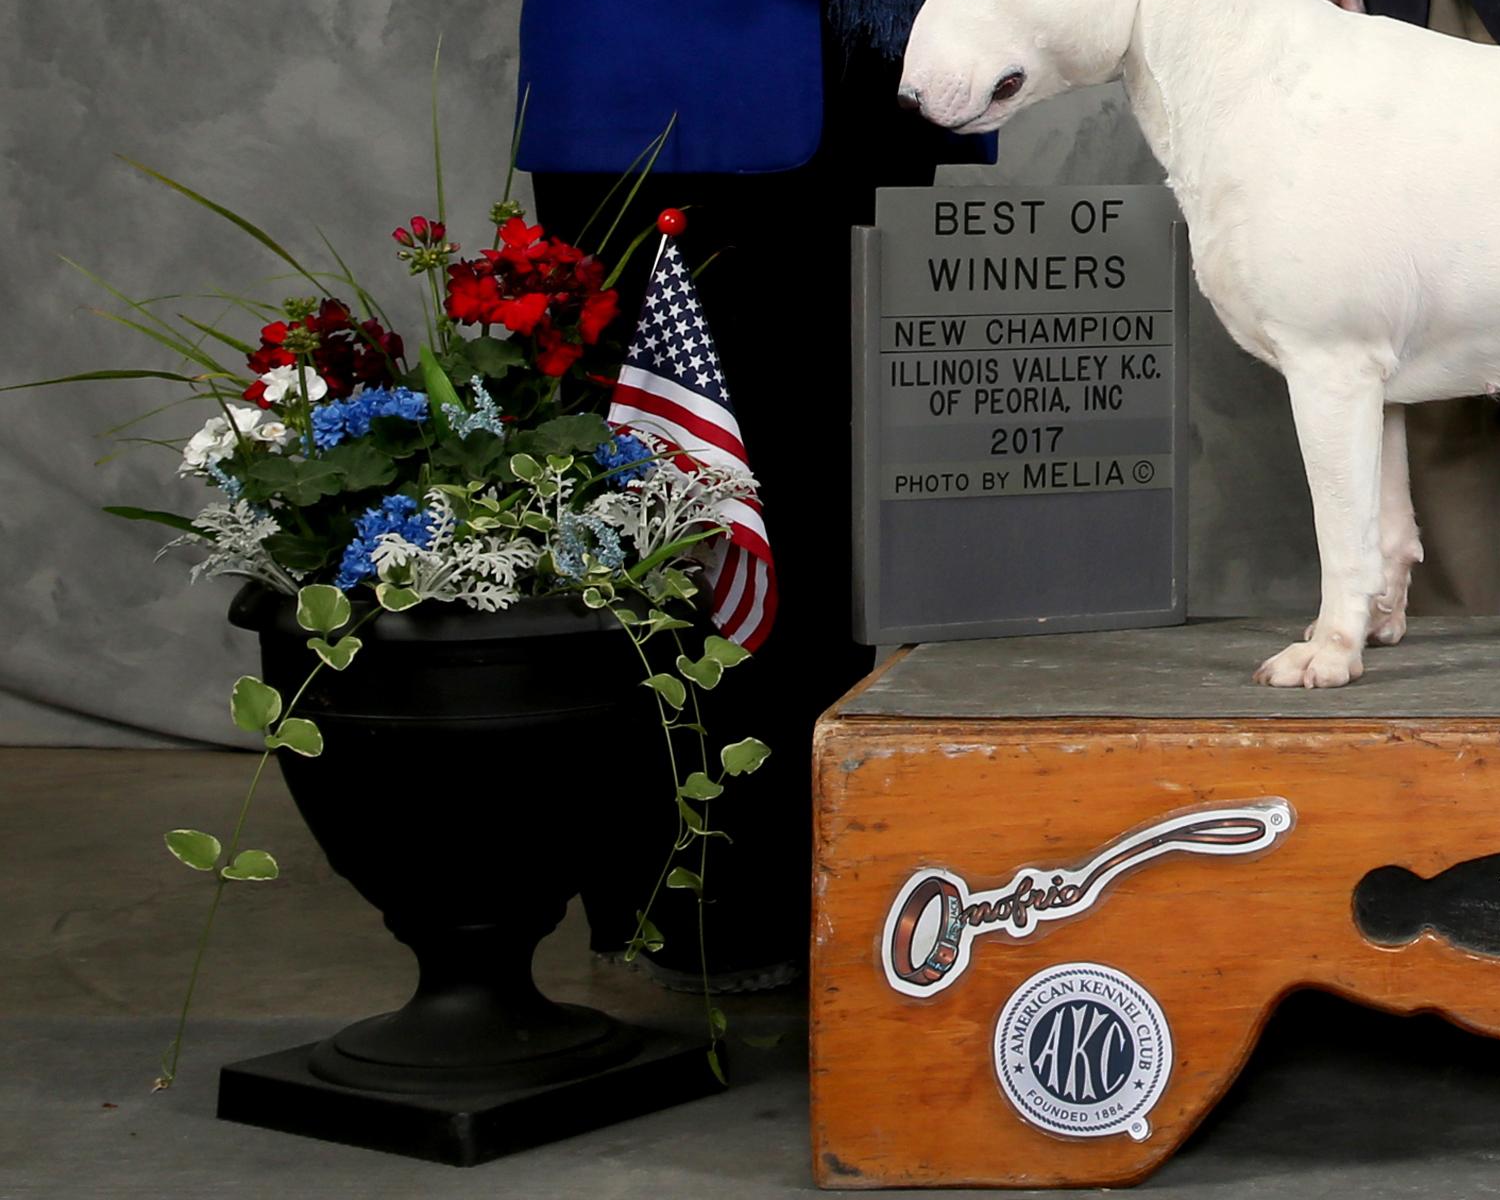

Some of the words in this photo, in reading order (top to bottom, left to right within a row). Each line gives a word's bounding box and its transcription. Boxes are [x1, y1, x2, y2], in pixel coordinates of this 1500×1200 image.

[935, 201, 1045, 236] BEST
[1070, 200, 1124, 234] OF
[928, 255, 1126, 292] WINNERS
[894, 320, 967, 348] NEW
[985, 315, 1154, 345] CHAMPION
[890, 358, 999, 387] ILLINOIS
[1012, 355, 1108, 384] VALLEY
[1121, 354, 1161, 380] K.C.
[929, 389, 962, 416] OF
[974, 386, 1071, 414] PEORIA,
[1084, 385, 1123, 410] INC
[990, 426, 1065, 455] 2017
[895, 473, 970, 494] PHOTO
[982, 472, 1010, 491] BY
[1023, 460, 1125, 489] MELIA
[1010, 980, 1075, 1055] AMERICAN
[1079, 978, 1138, 1024] KENNEL
[1136, 1023, 1154, 1071] CLUB
[1032, 1003, 1127, 1102] AKC
[1025, 1088, 1089, 1123] FOUNDED
[1094, 1103, 1124, 1121] 1884
